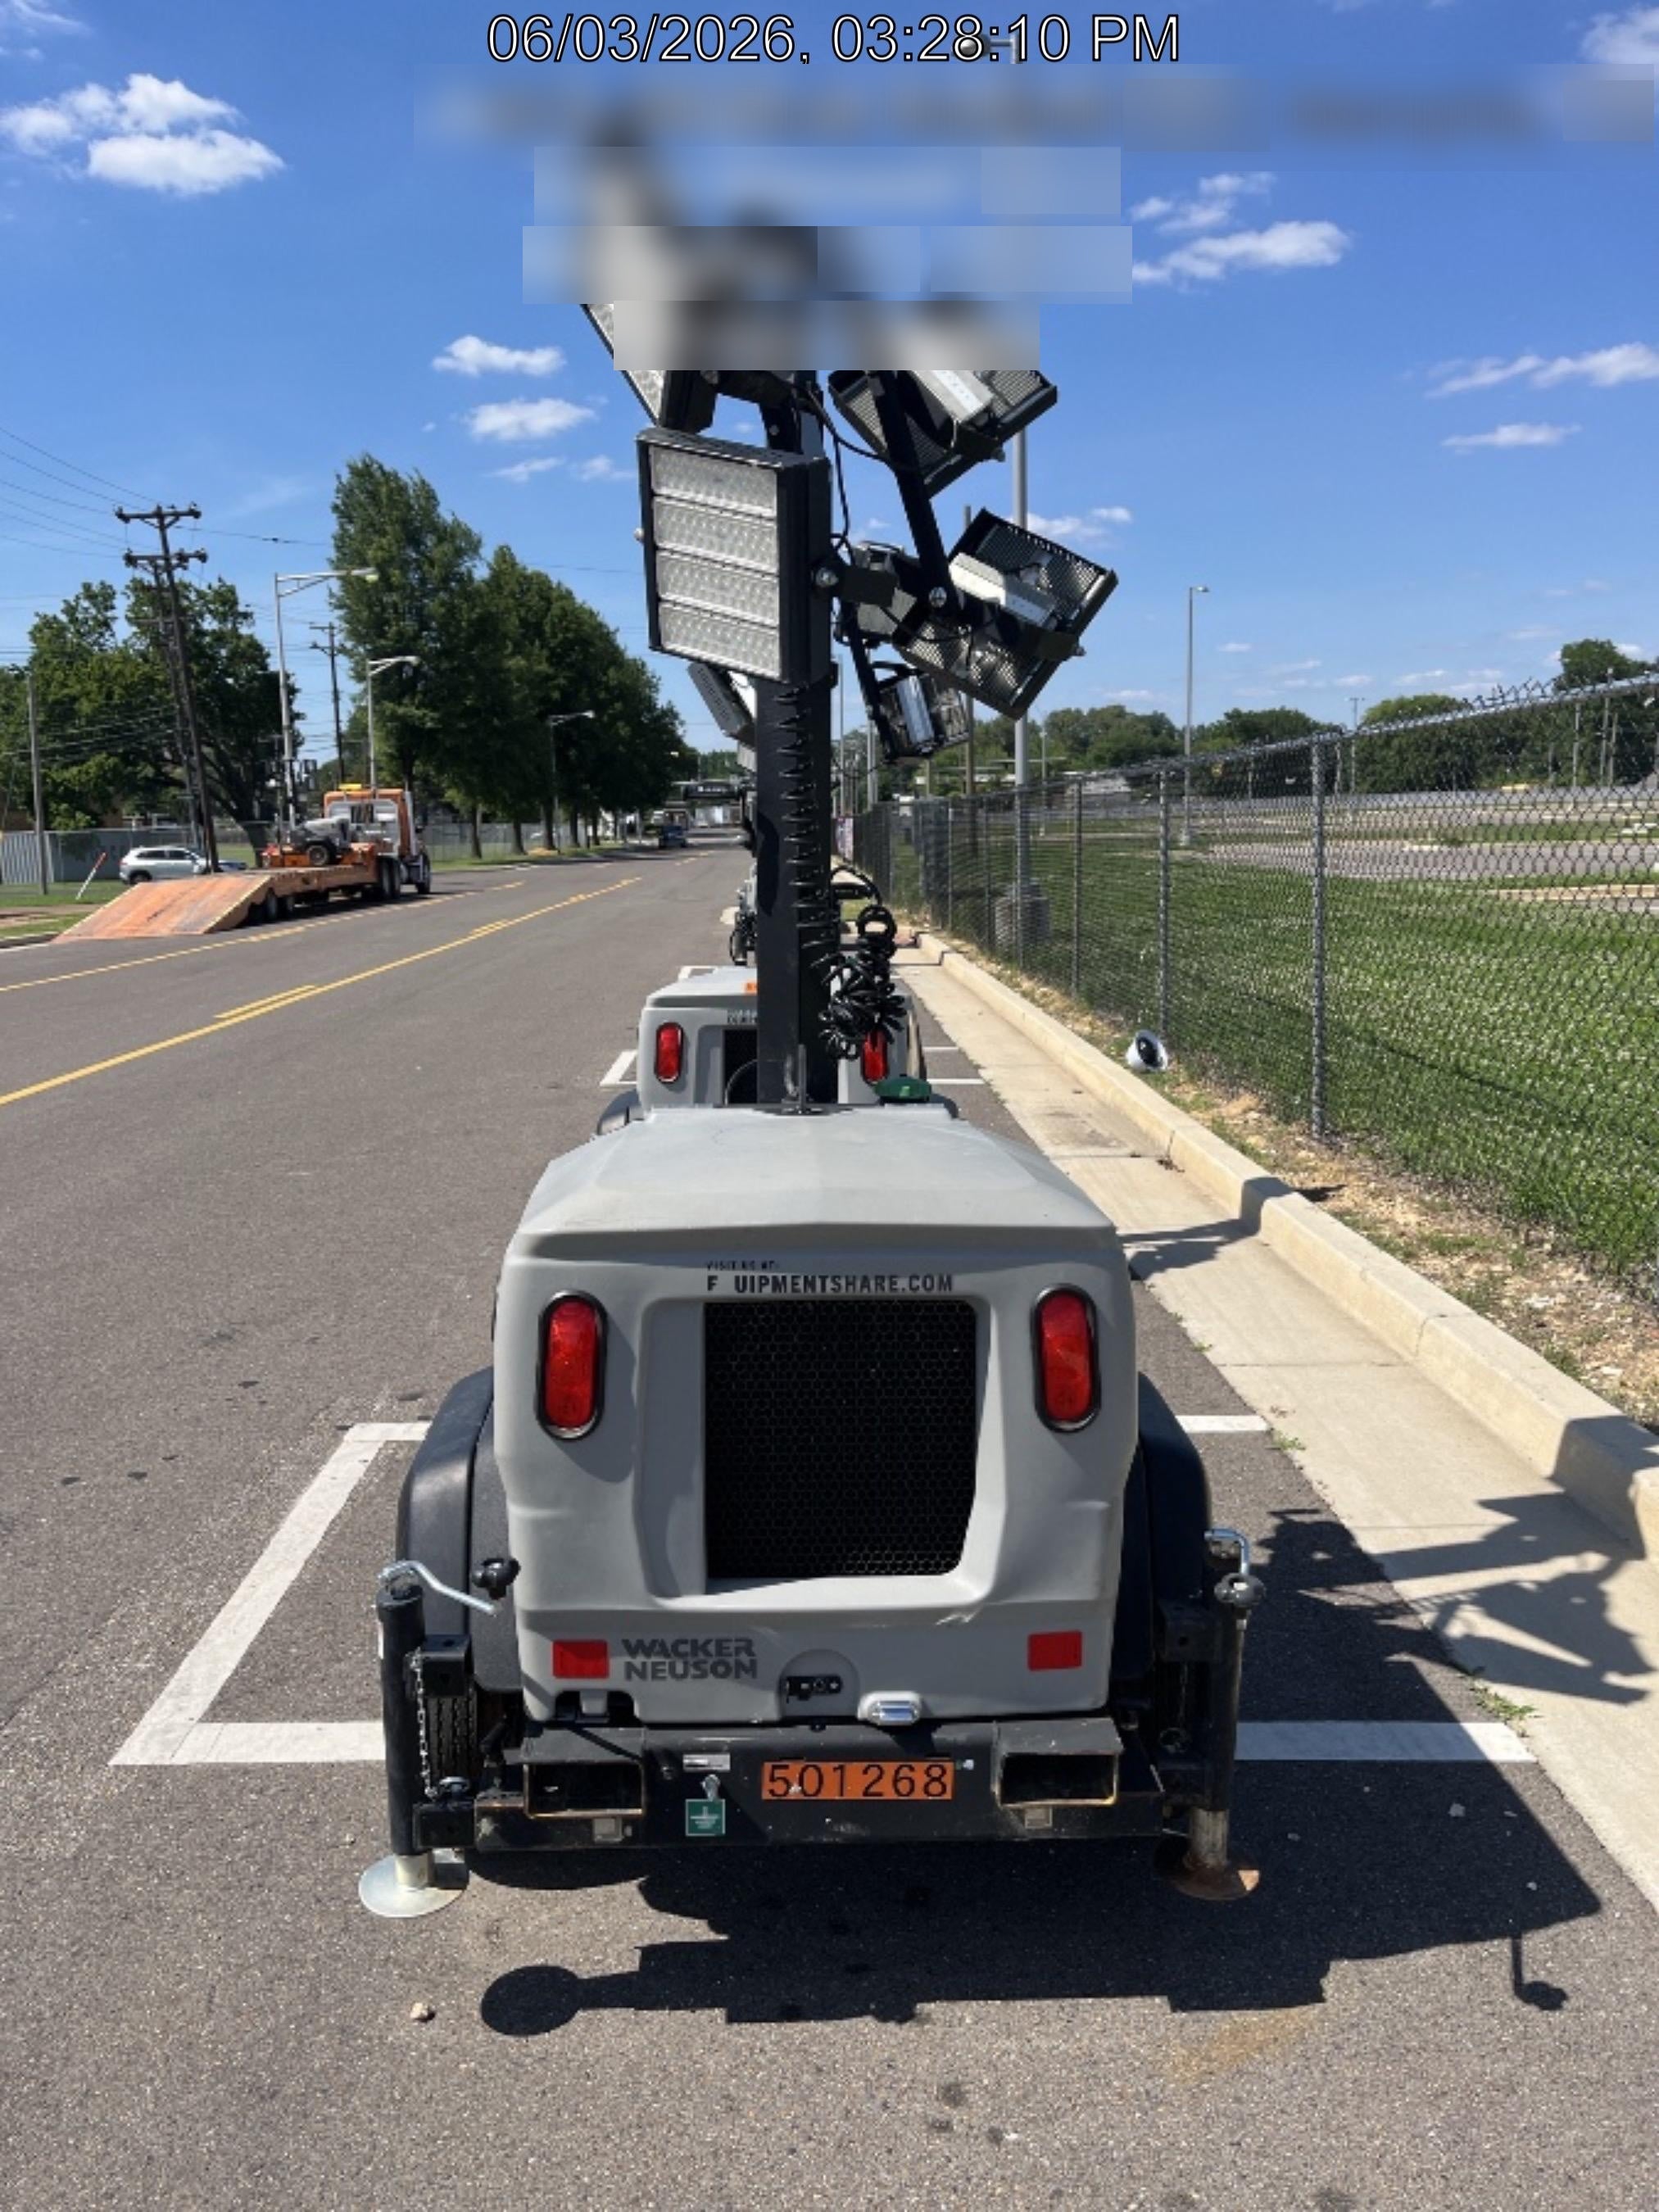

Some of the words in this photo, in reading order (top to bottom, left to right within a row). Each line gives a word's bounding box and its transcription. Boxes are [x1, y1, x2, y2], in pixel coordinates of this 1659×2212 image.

[622, 1638, 755, 1658] WACKER
[624, 1658, 758, 1680] NEUSON
[768, 1764, 947, 1797] 501268
